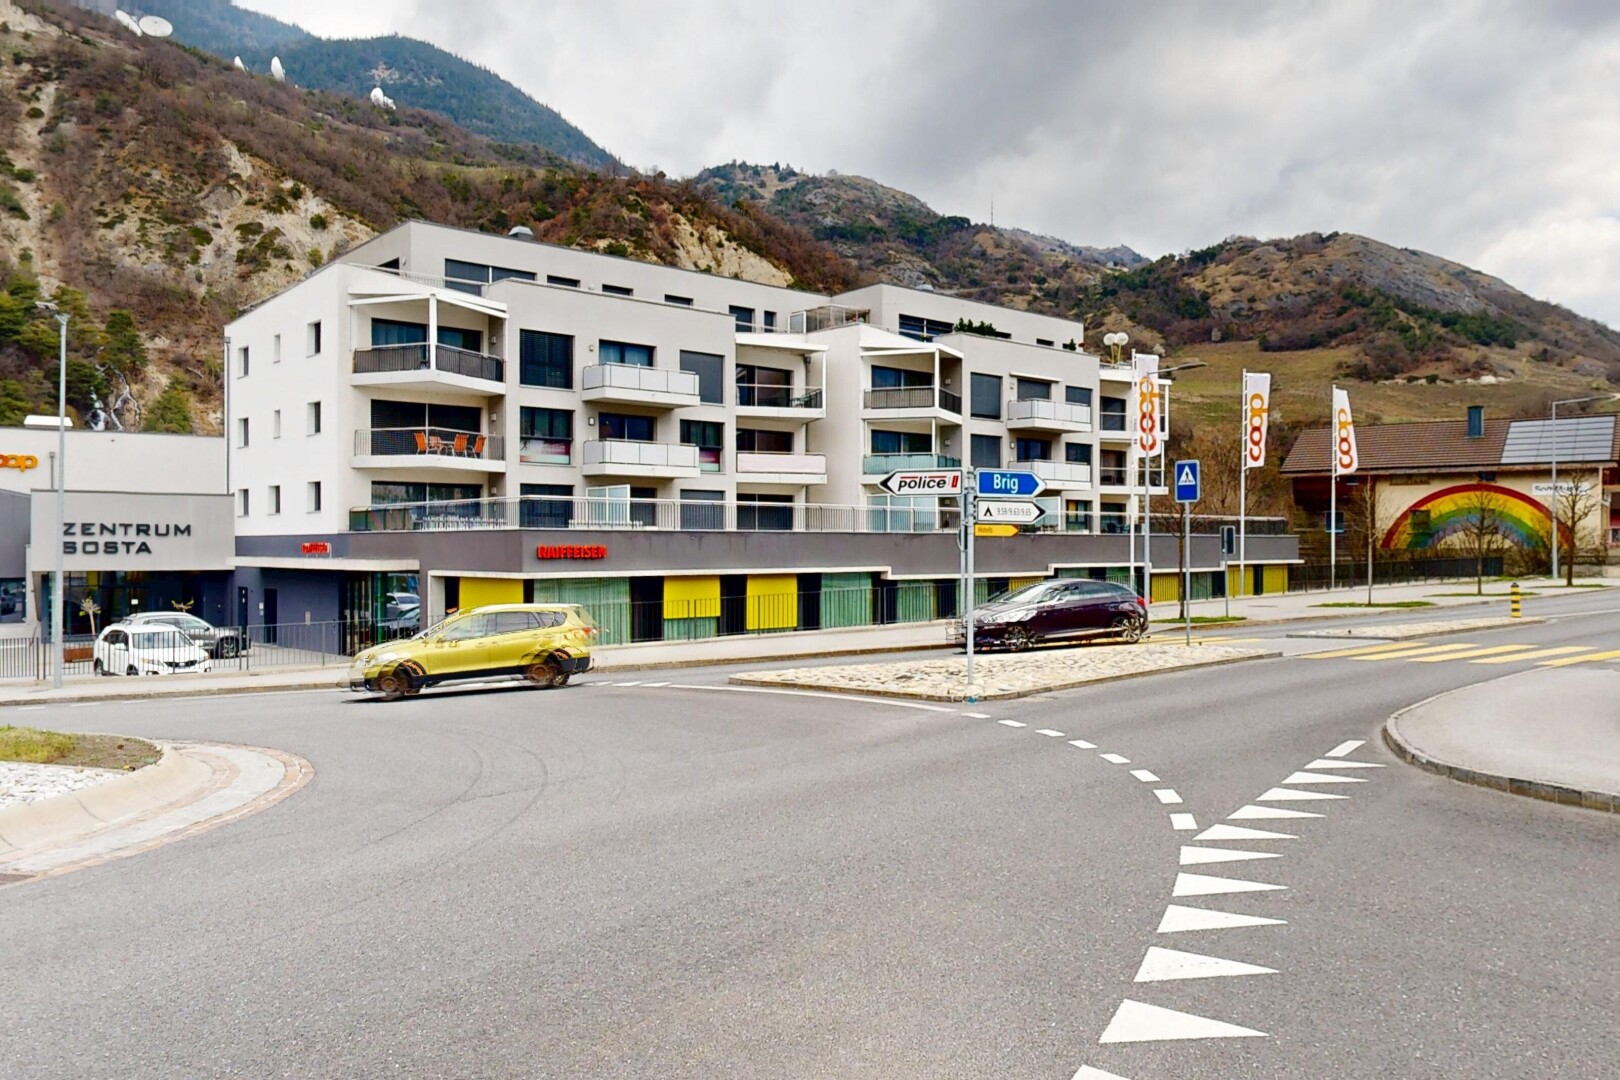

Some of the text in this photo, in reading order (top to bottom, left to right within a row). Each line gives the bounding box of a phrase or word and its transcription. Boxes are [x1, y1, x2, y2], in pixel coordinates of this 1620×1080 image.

[1250, 393, 1270, 462] coop
[1338, 408, 1353, 469] coop
[897, 475, 947, 492] police
[993, 473, 1019, 494] Brig
[63, 522, 192, 537] ZENTRUM
[63, 541, 152, 554] SOSTA
[537, 544, 608, 559] RAIFFEISEN
